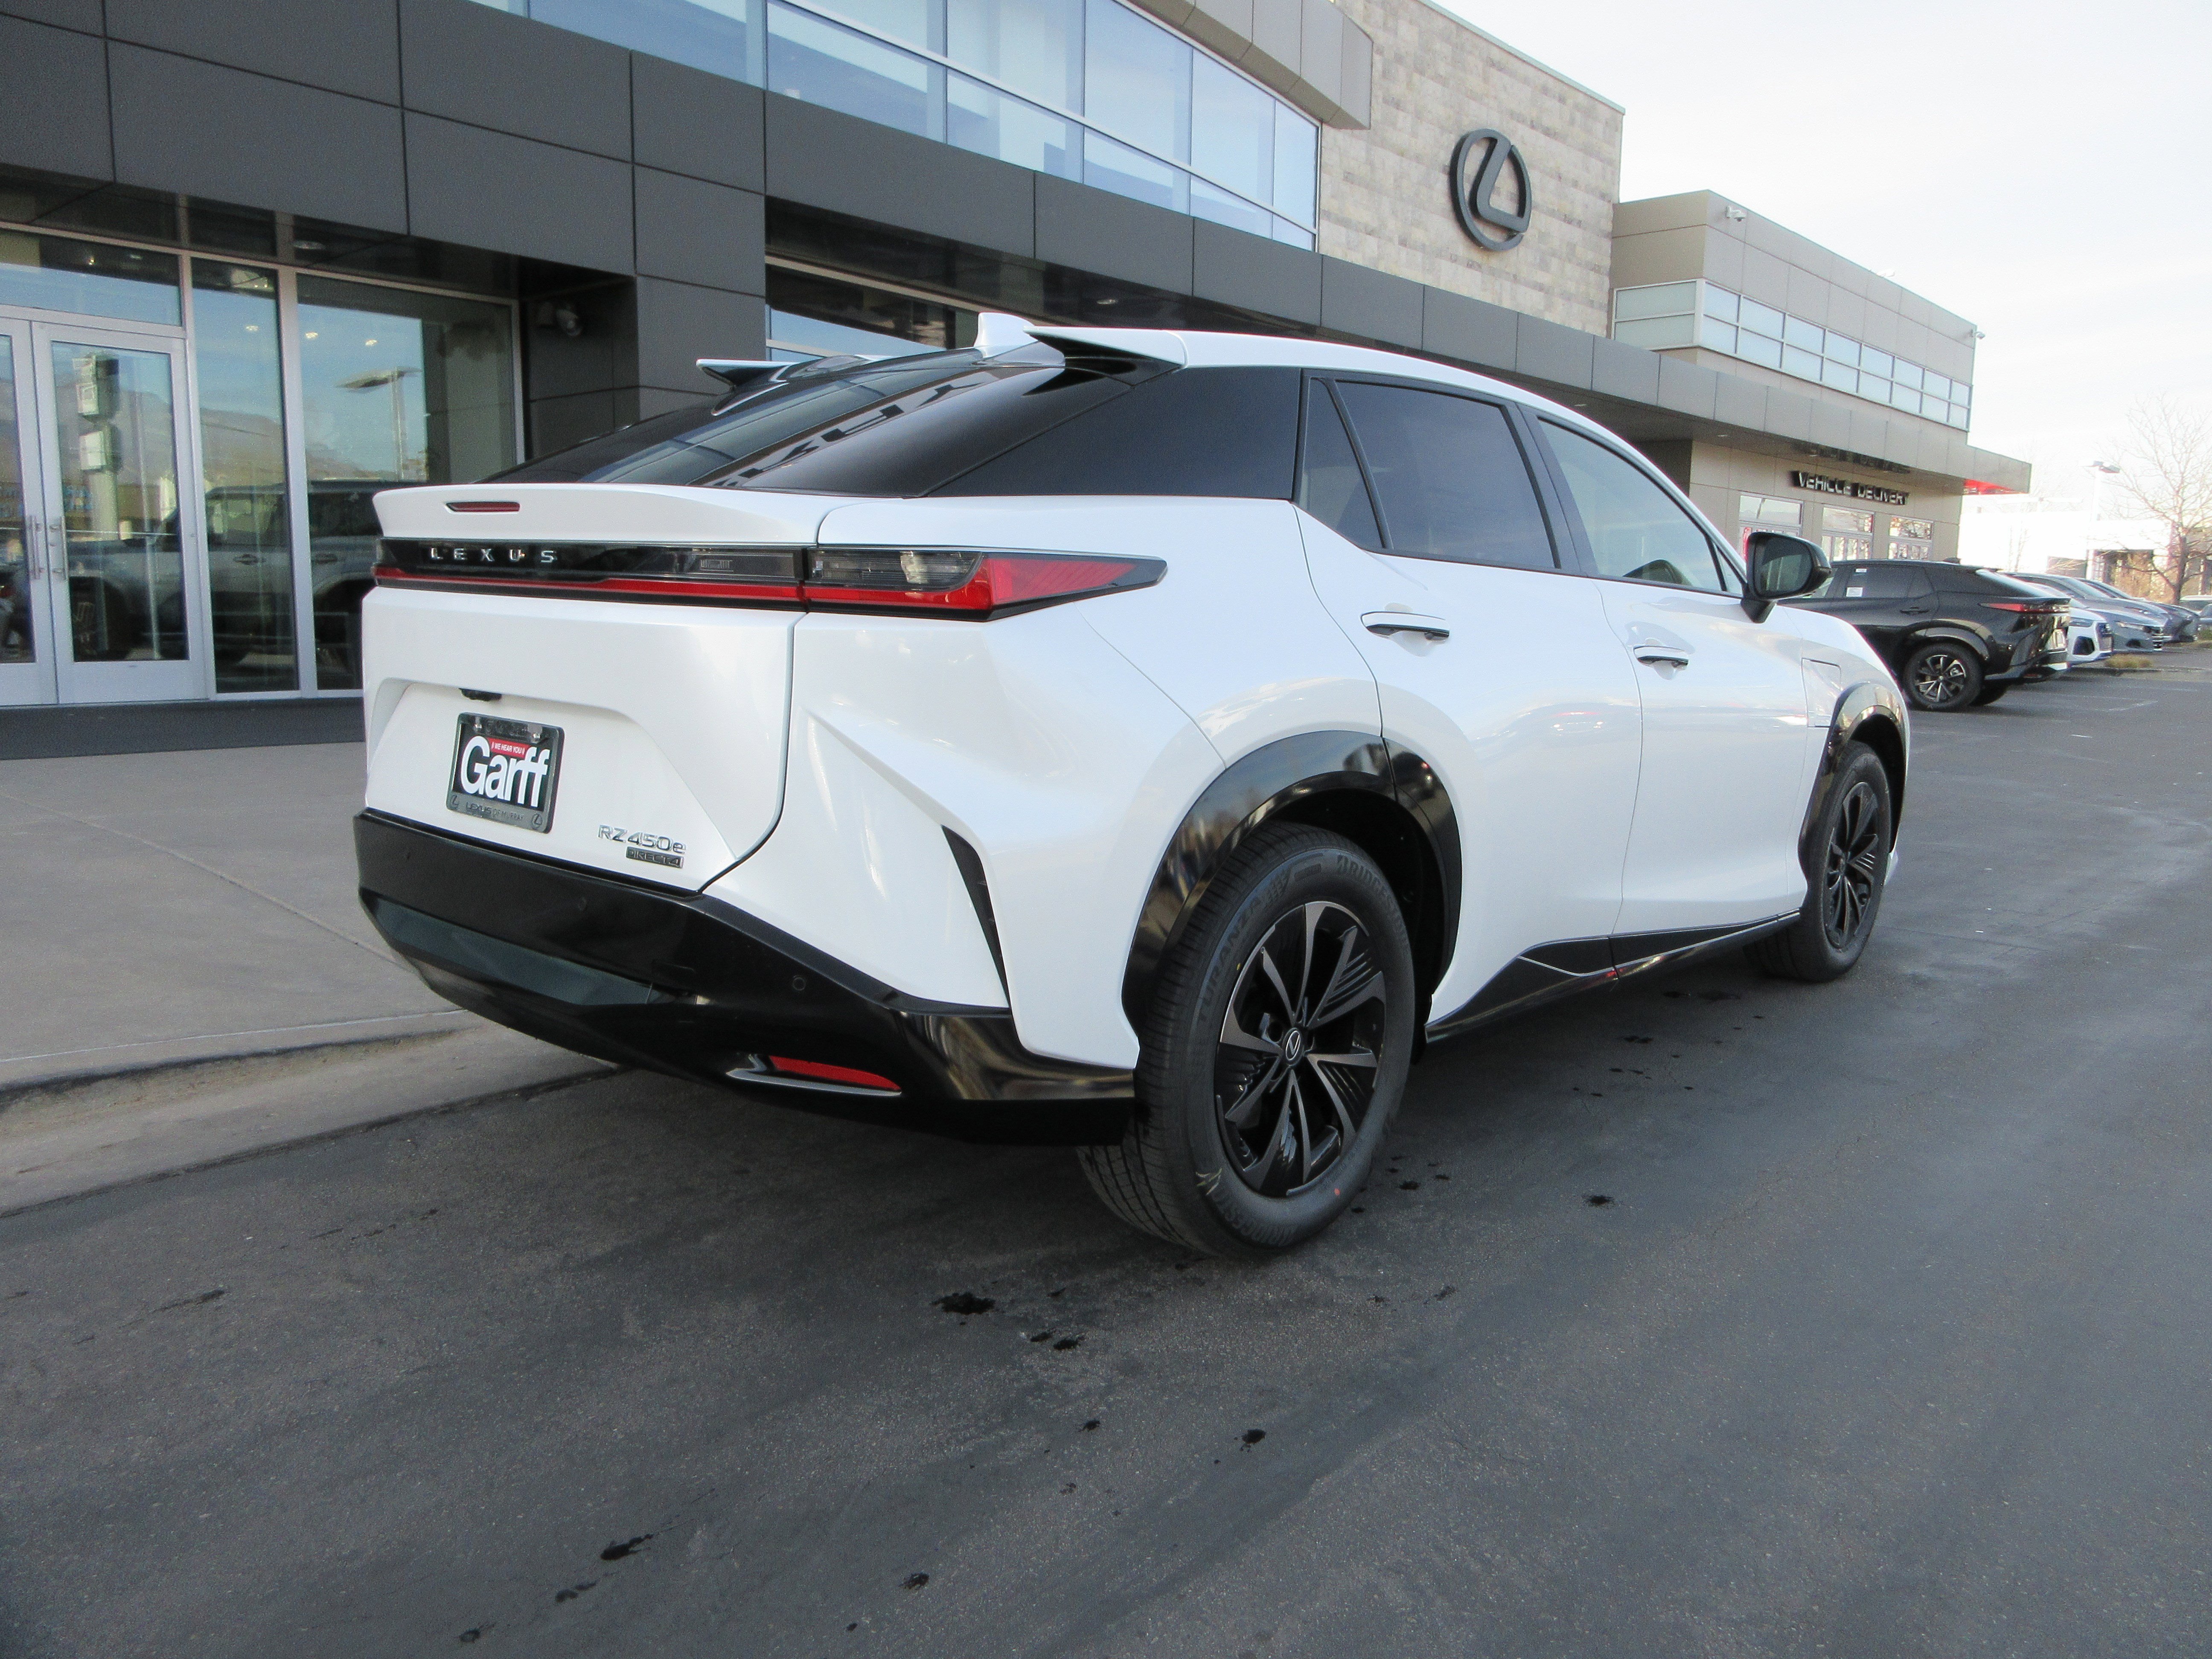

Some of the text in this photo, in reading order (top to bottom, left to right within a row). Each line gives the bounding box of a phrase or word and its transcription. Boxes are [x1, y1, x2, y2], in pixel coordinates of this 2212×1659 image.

[1794, 470, 1909, 505] VEHICLE DELIVERY
[431, 547, 557, 563] LEXUS
[501, 744, 512, 752] HEAR
[461, 736, 550, 807] Garff
[466, 802, 492, 814] LEXUS
